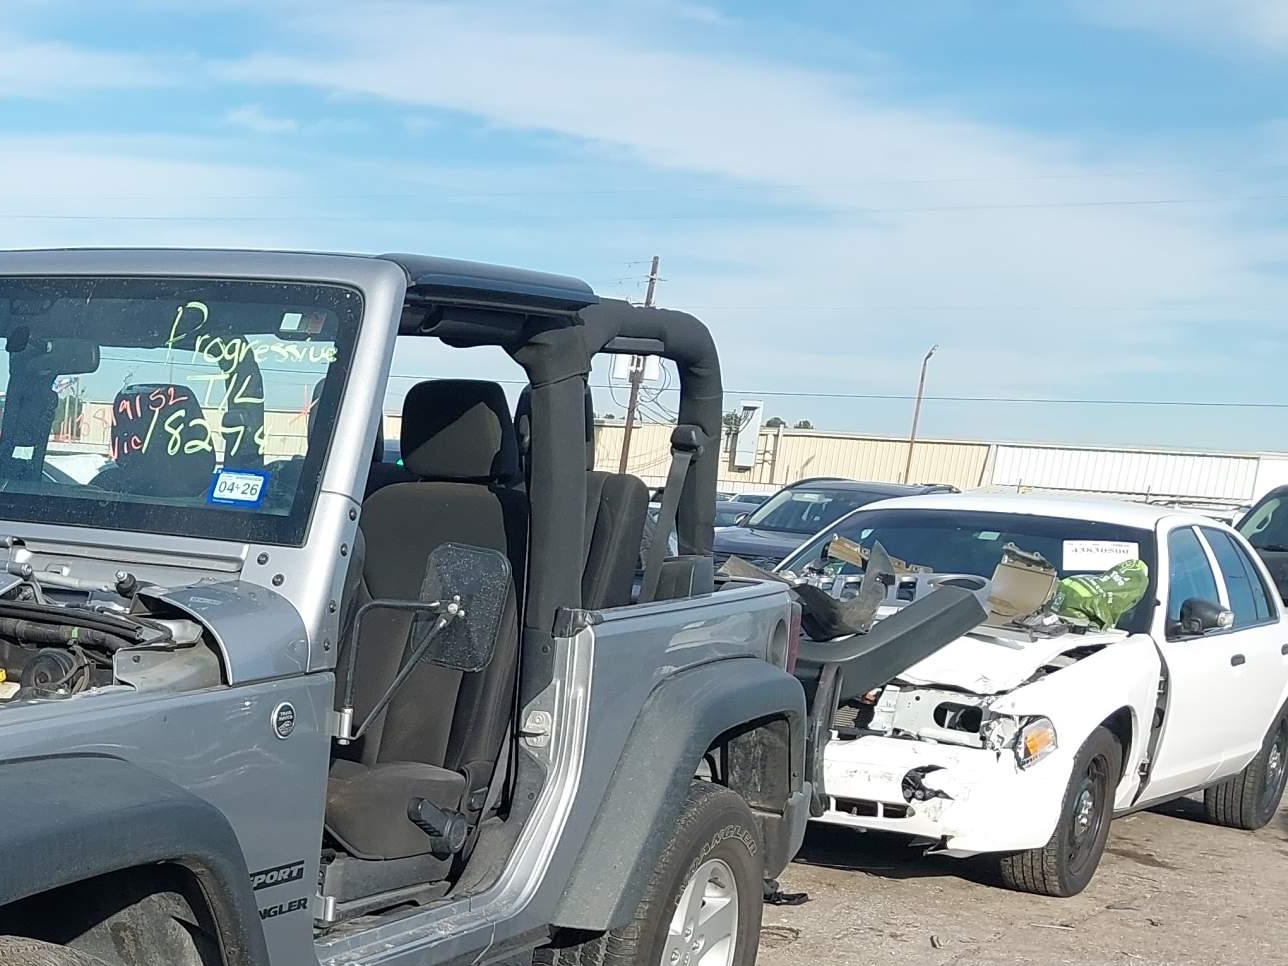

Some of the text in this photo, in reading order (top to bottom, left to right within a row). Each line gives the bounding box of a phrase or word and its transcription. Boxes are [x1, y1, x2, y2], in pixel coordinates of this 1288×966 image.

[165, 301, 339, 374] Progressive
[250, 864, 304, 888] PORT
[258, 897, 309, 920] NGLER
